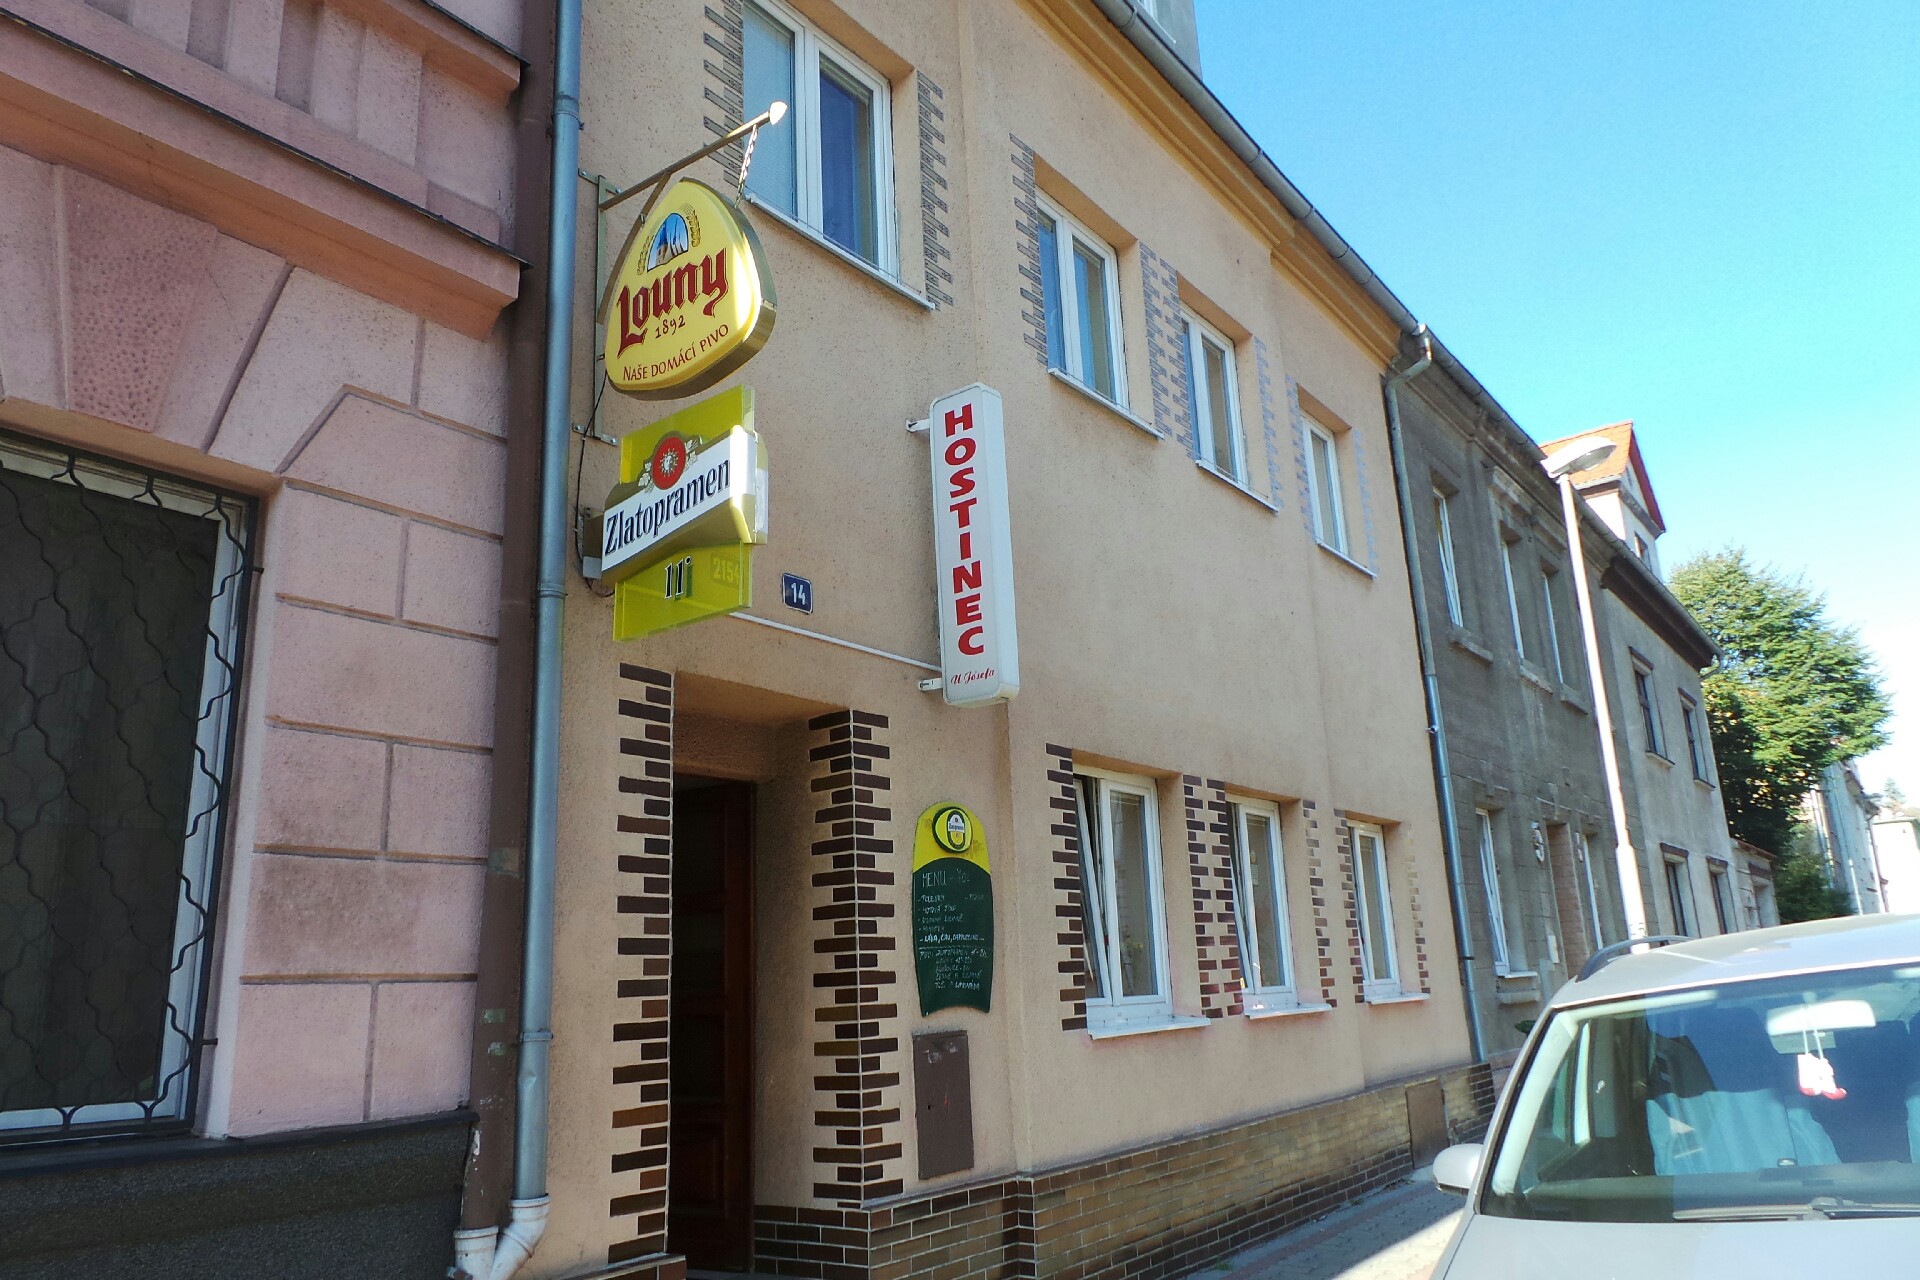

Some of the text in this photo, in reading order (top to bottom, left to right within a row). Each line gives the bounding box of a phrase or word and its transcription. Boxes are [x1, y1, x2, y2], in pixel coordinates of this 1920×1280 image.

[616, 247, 729, 359] Louny
[654, 314, 686, 339] 1892
[623, 323, 729, 381] NAŠE DOMÁCÍ PIVO
[604, 457, 730, 557] Zlatopramen
[944, 402, 985, 656] HOSTINEC
[790, 582, 806, 605] 14
[922, 870, 947, 888] MENU
